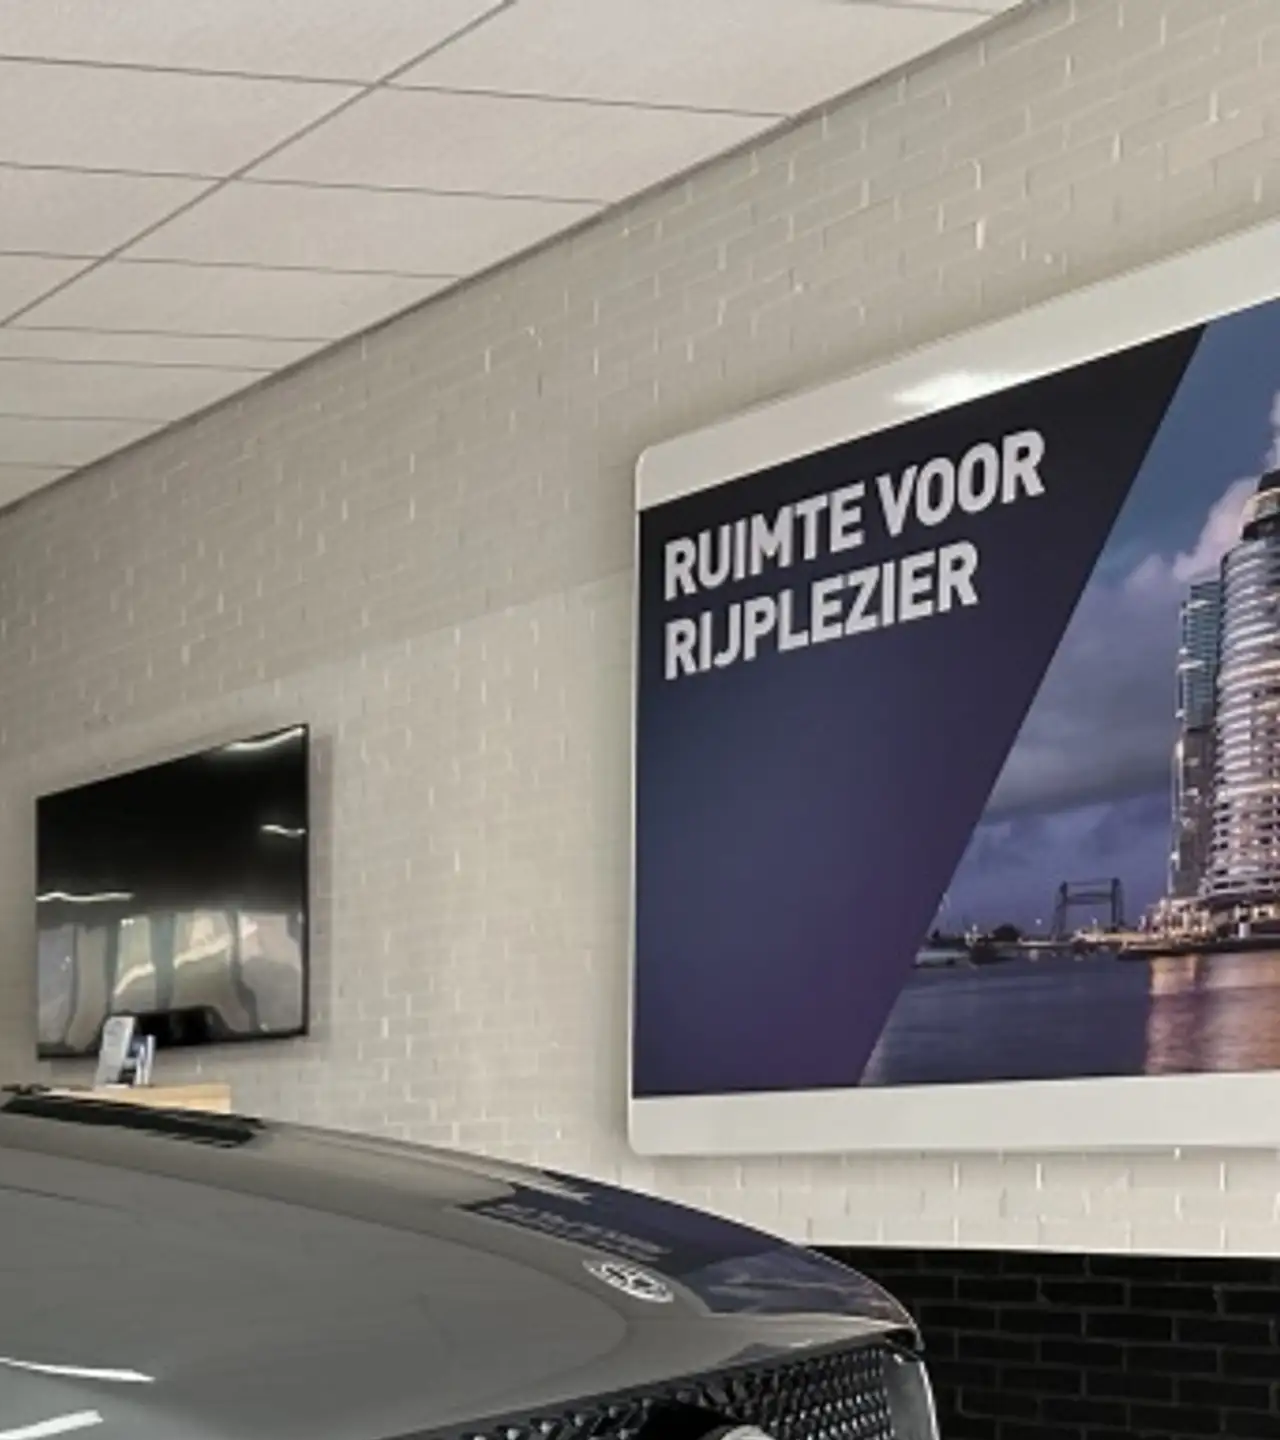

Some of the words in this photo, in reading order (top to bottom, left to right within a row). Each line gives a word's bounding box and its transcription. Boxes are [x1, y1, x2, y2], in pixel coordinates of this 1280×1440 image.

[663, 483, 864, 600] RUIMTE
[877, 429, 1046, 537] VOOR
[663, 540, 980, 681] RIJPLEZIER
